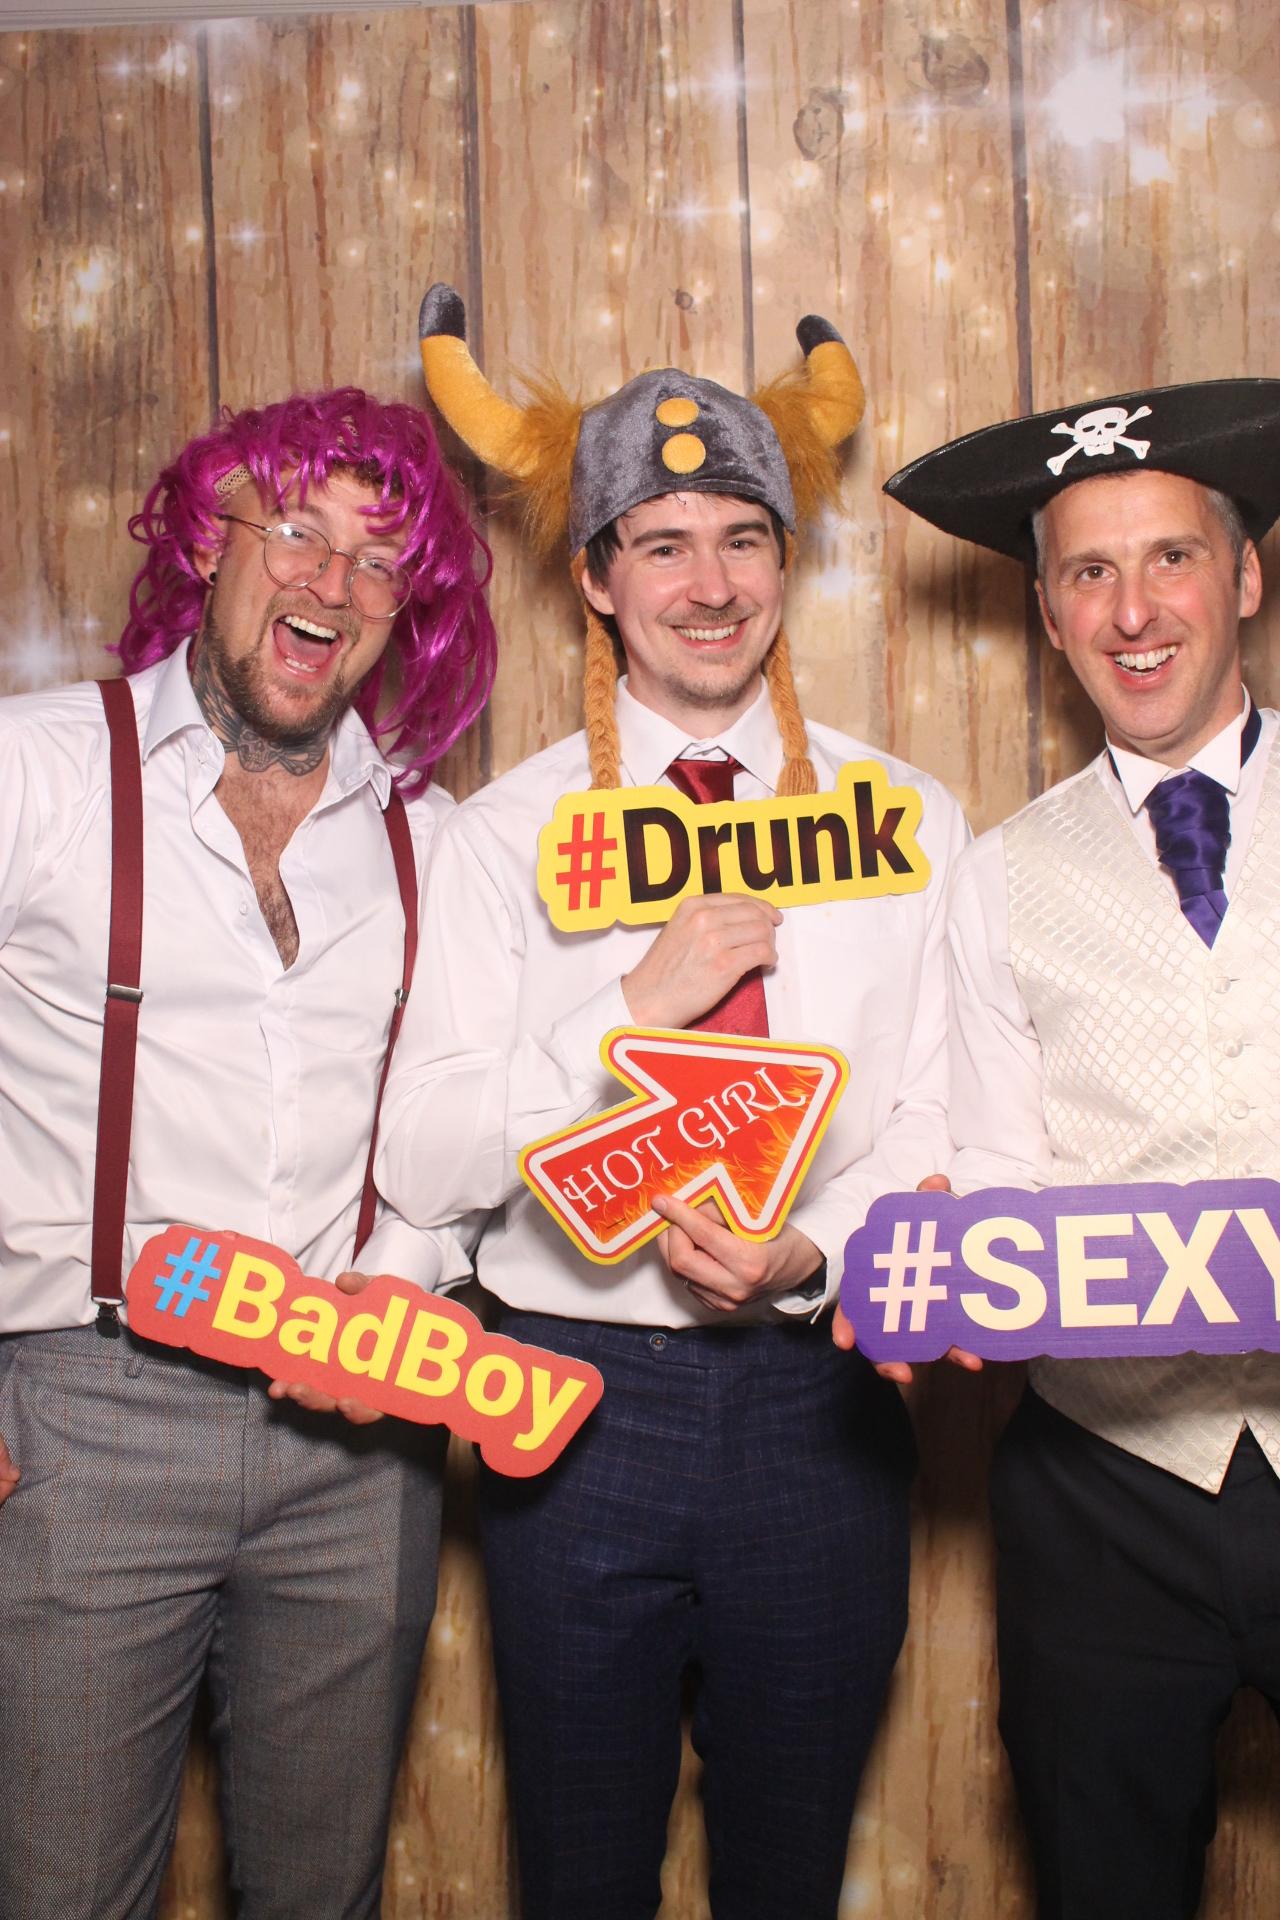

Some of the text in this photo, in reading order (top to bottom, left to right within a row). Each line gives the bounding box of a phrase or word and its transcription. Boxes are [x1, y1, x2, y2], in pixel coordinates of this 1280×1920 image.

[555, 780, 914, 912] #Drunk
[563, 1066, 807, 1213] HOT GIRL
[153, 1236, 588, 1452] #BadBoy
